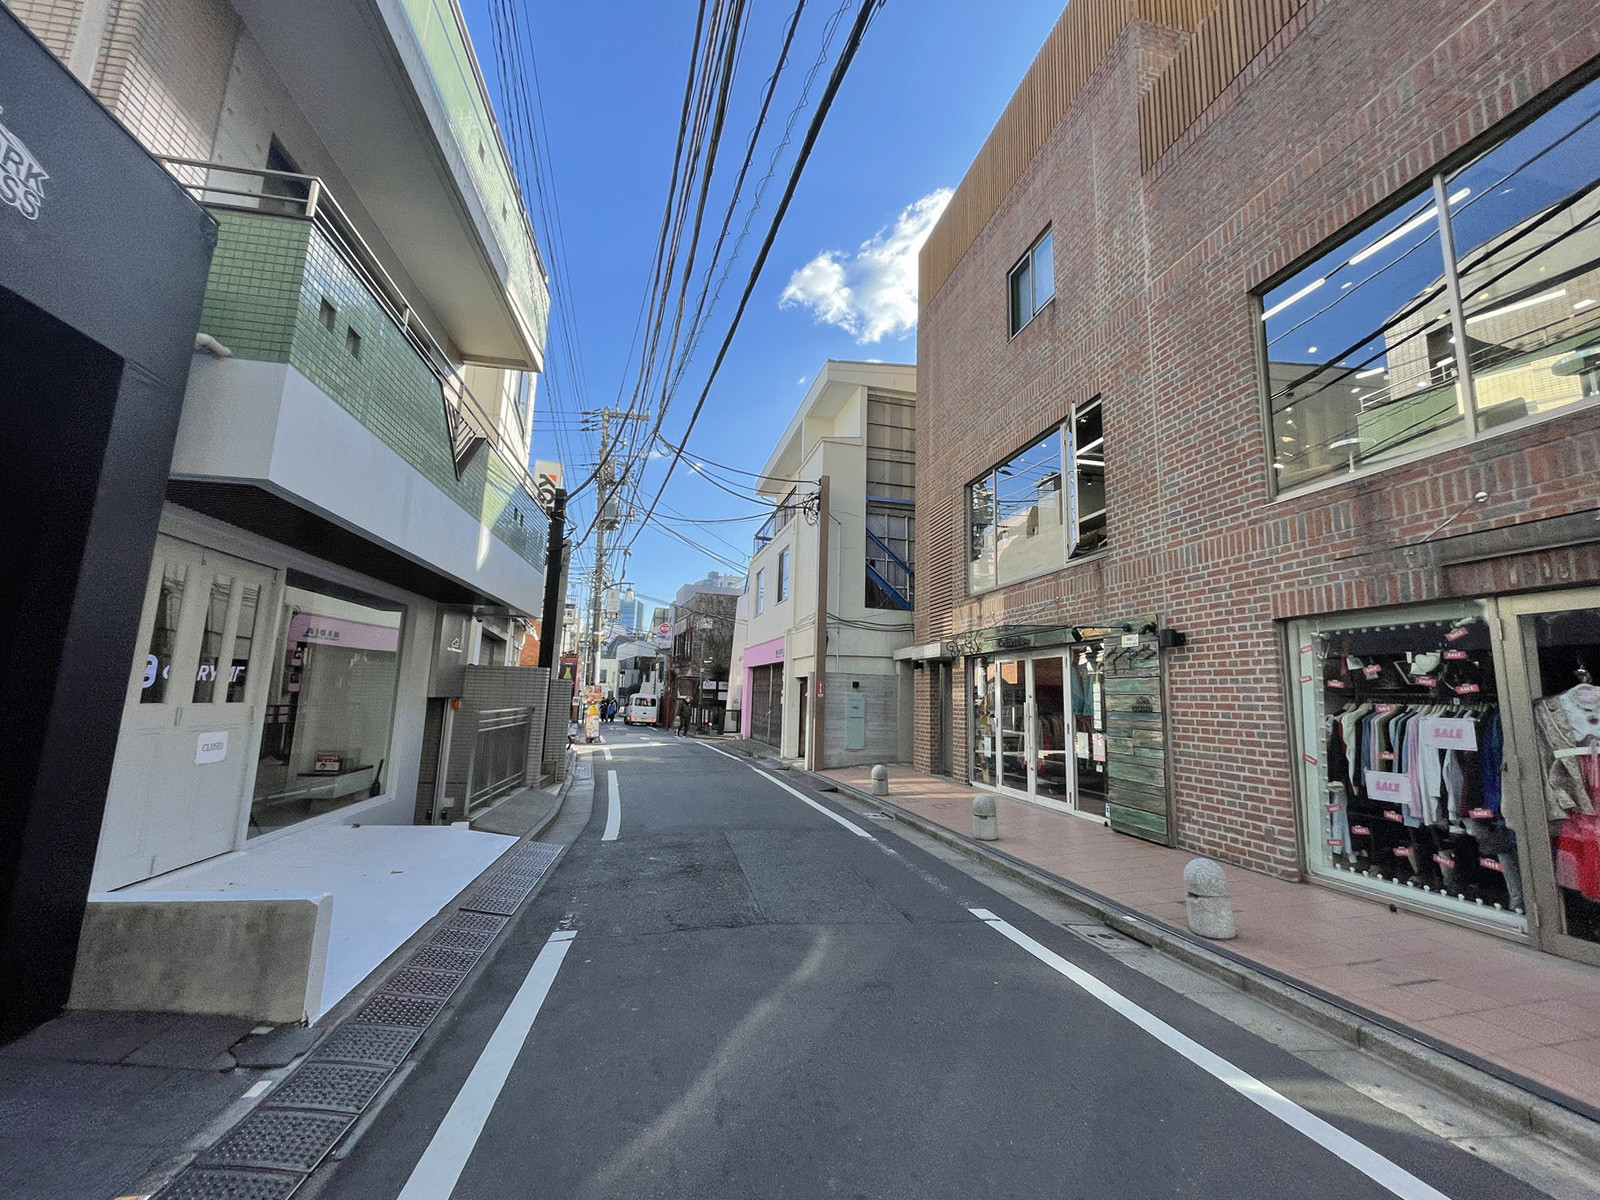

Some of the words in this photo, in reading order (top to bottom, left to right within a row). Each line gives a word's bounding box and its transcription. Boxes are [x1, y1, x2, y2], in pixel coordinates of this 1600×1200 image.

[0, 141, 49, 195] RK
[1434, 727, 1463, 740] SALE
[1374, 780, 1400, 793] SALE
